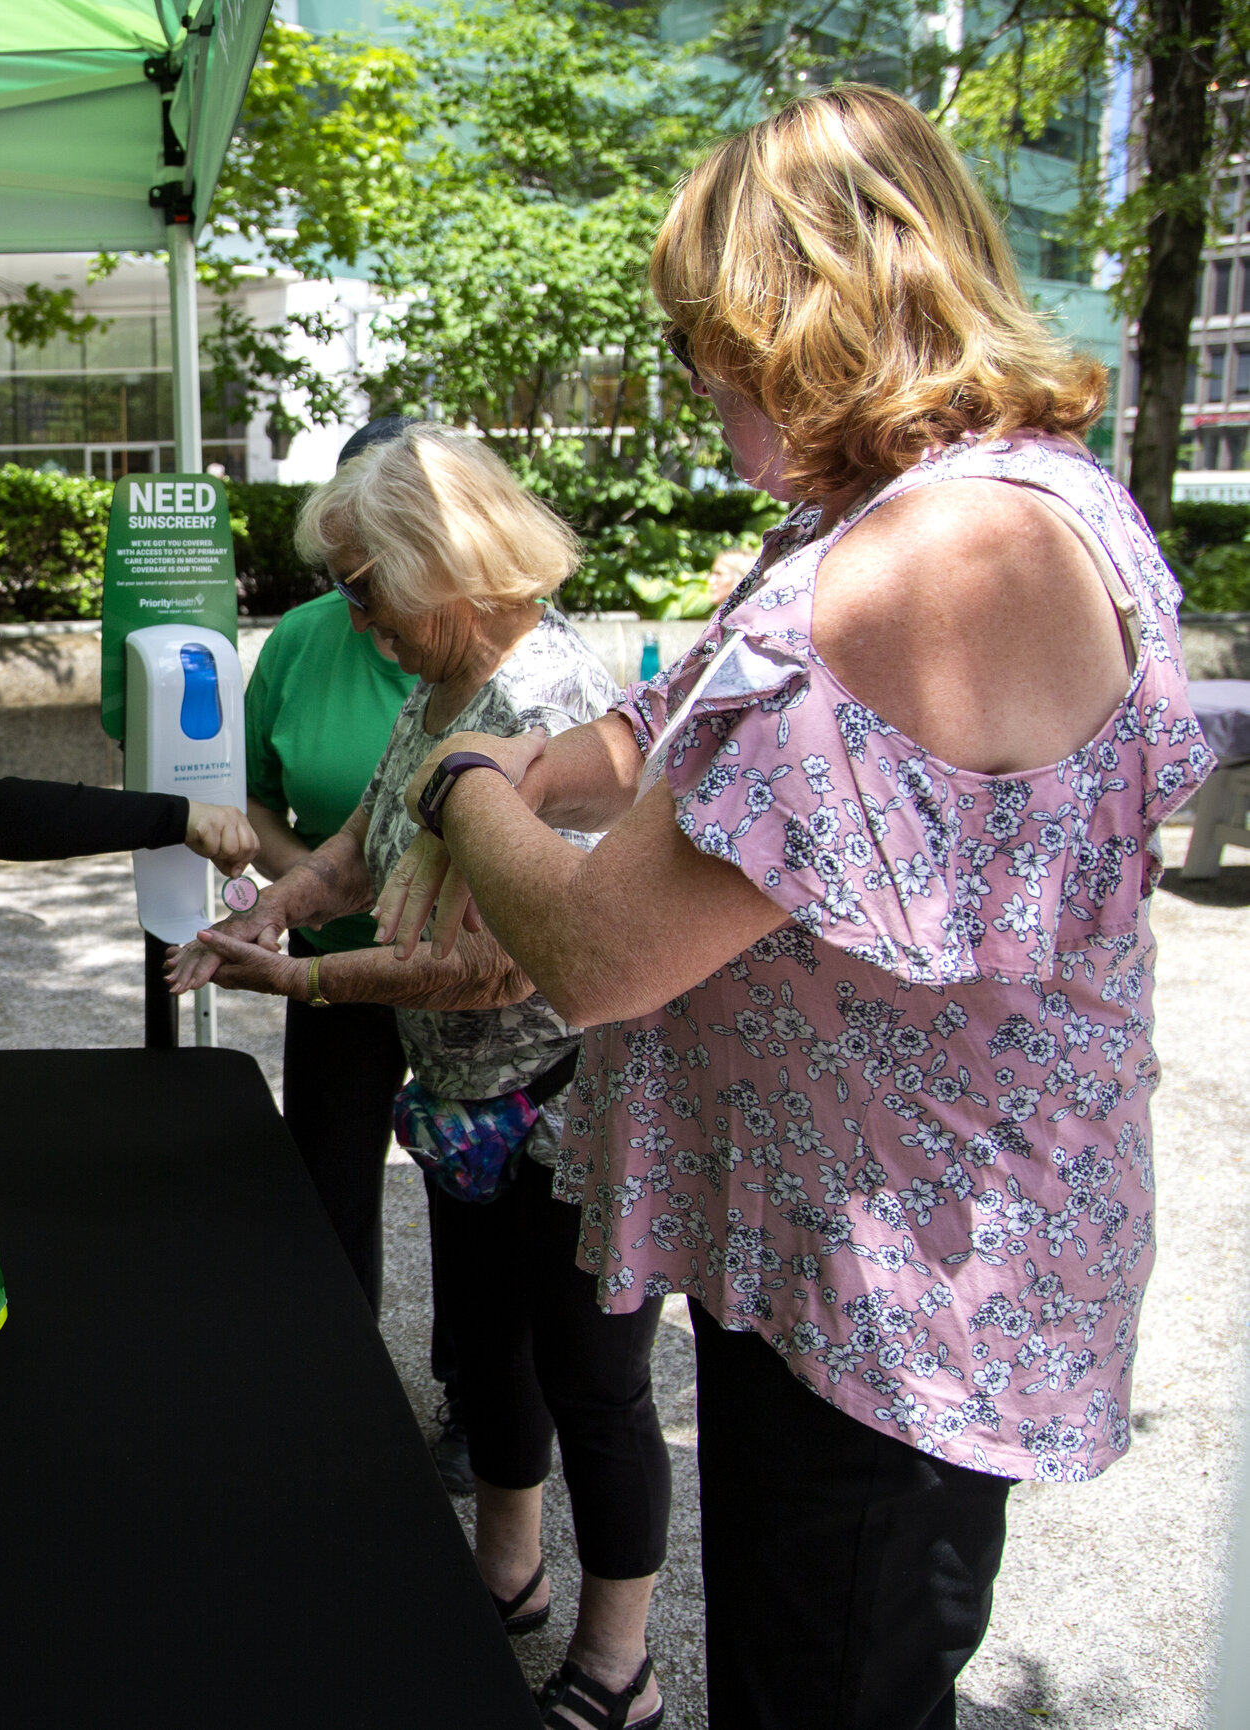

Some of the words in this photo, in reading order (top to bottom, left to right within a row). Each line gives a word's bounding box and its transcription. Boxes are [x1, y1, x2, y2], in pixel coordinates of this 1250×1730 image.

[129, 482, 216, 513] NEED
[128, 515, 217, 530] SUNSCREEN?
[197, 548, 228, 556] PRIMARY
[185, 557, 220, 565] MICHIGAN,
[131, 566, 166, 574] COVERAGE
[139, 598, 198, 608] PriorityHealth
[174, 762, 231, 772] SUNSTATION
